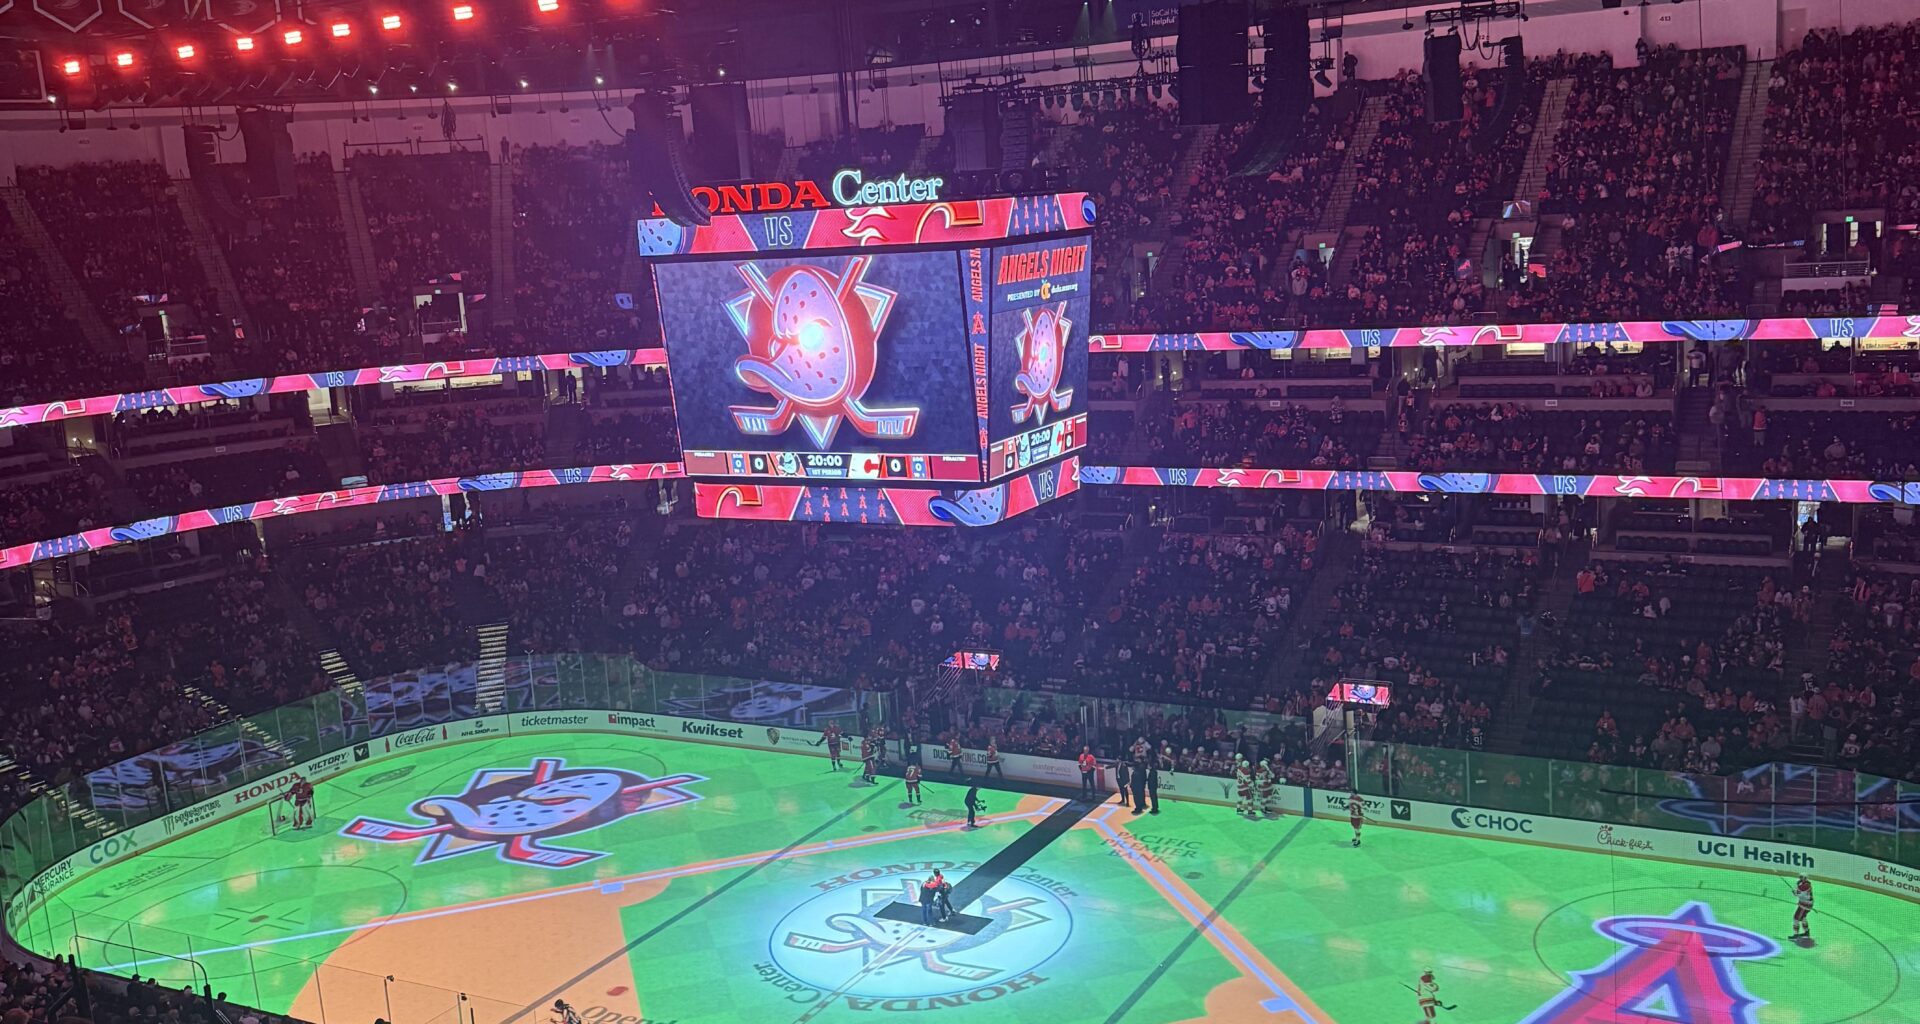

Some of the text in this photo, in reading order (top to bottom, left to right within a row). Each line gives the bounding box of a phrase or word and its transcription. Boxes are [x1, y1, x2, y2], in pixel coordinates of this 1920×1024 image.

[1151, 8, 1170, 18] SoCal
[1151, 16, 1176, 26] Helpful
[649, 170, 945, 216] ONDA Center
[763, 216, 793, 246] VS
[997, 244, 1088, 285] ANGELS NIGHT
[971, 258, 983, 303] ANGELS
[1007, 290, 1033, 302] PRESENTED
[1033, 288, 1040, 298] BY
[1830, 318, 1854, 338] VS
[1361, 329, 1381, 347] VS
[326, 372, 344, 387] VS
[974, 343, 988, 420] ANGELS NIGHT
[1031, 429, 1051, 446] 20:00
[1066, 434, 1072, 448] 0
[735, 460, 742, 469] 0
[754, 457, 764, 471] 0
[807, 454, 843, 467] 20:00
[890, 458, 899, 473] 0
[915, 462, 922, 472] 0
[1007, 455, 1013, 469] 0
[564, 468, 582, 484] VS
[1038, 469, 1053, 500] VS
[1168, 468, 1187, 486] VS
[1553, 475, 1577, 494] VS
[222, 505, 243, 523] VS
[521, 714, 588, 727] ticketmaster
[617, 713, 655, 728] impact
[682, 721, 743, 739] Kwikset
[308, 752, 347, 772] VICTORY
[234, 772, 300, 804] HONDA
[1474, 813, 1534, 834] CHOC
[89, 830, 138, 864] COX
[1100, 838, 1198, 859] PREMIER
[1118, 831, 1203, 850] PACIFIC
[1697, 840, 1815, 868] UCI Health
[33, 858, 73, 890] MERCURY
[810, 861, 1078, 899] HONDA Center
[753, 960, 1050, 1012] HONDA Center
